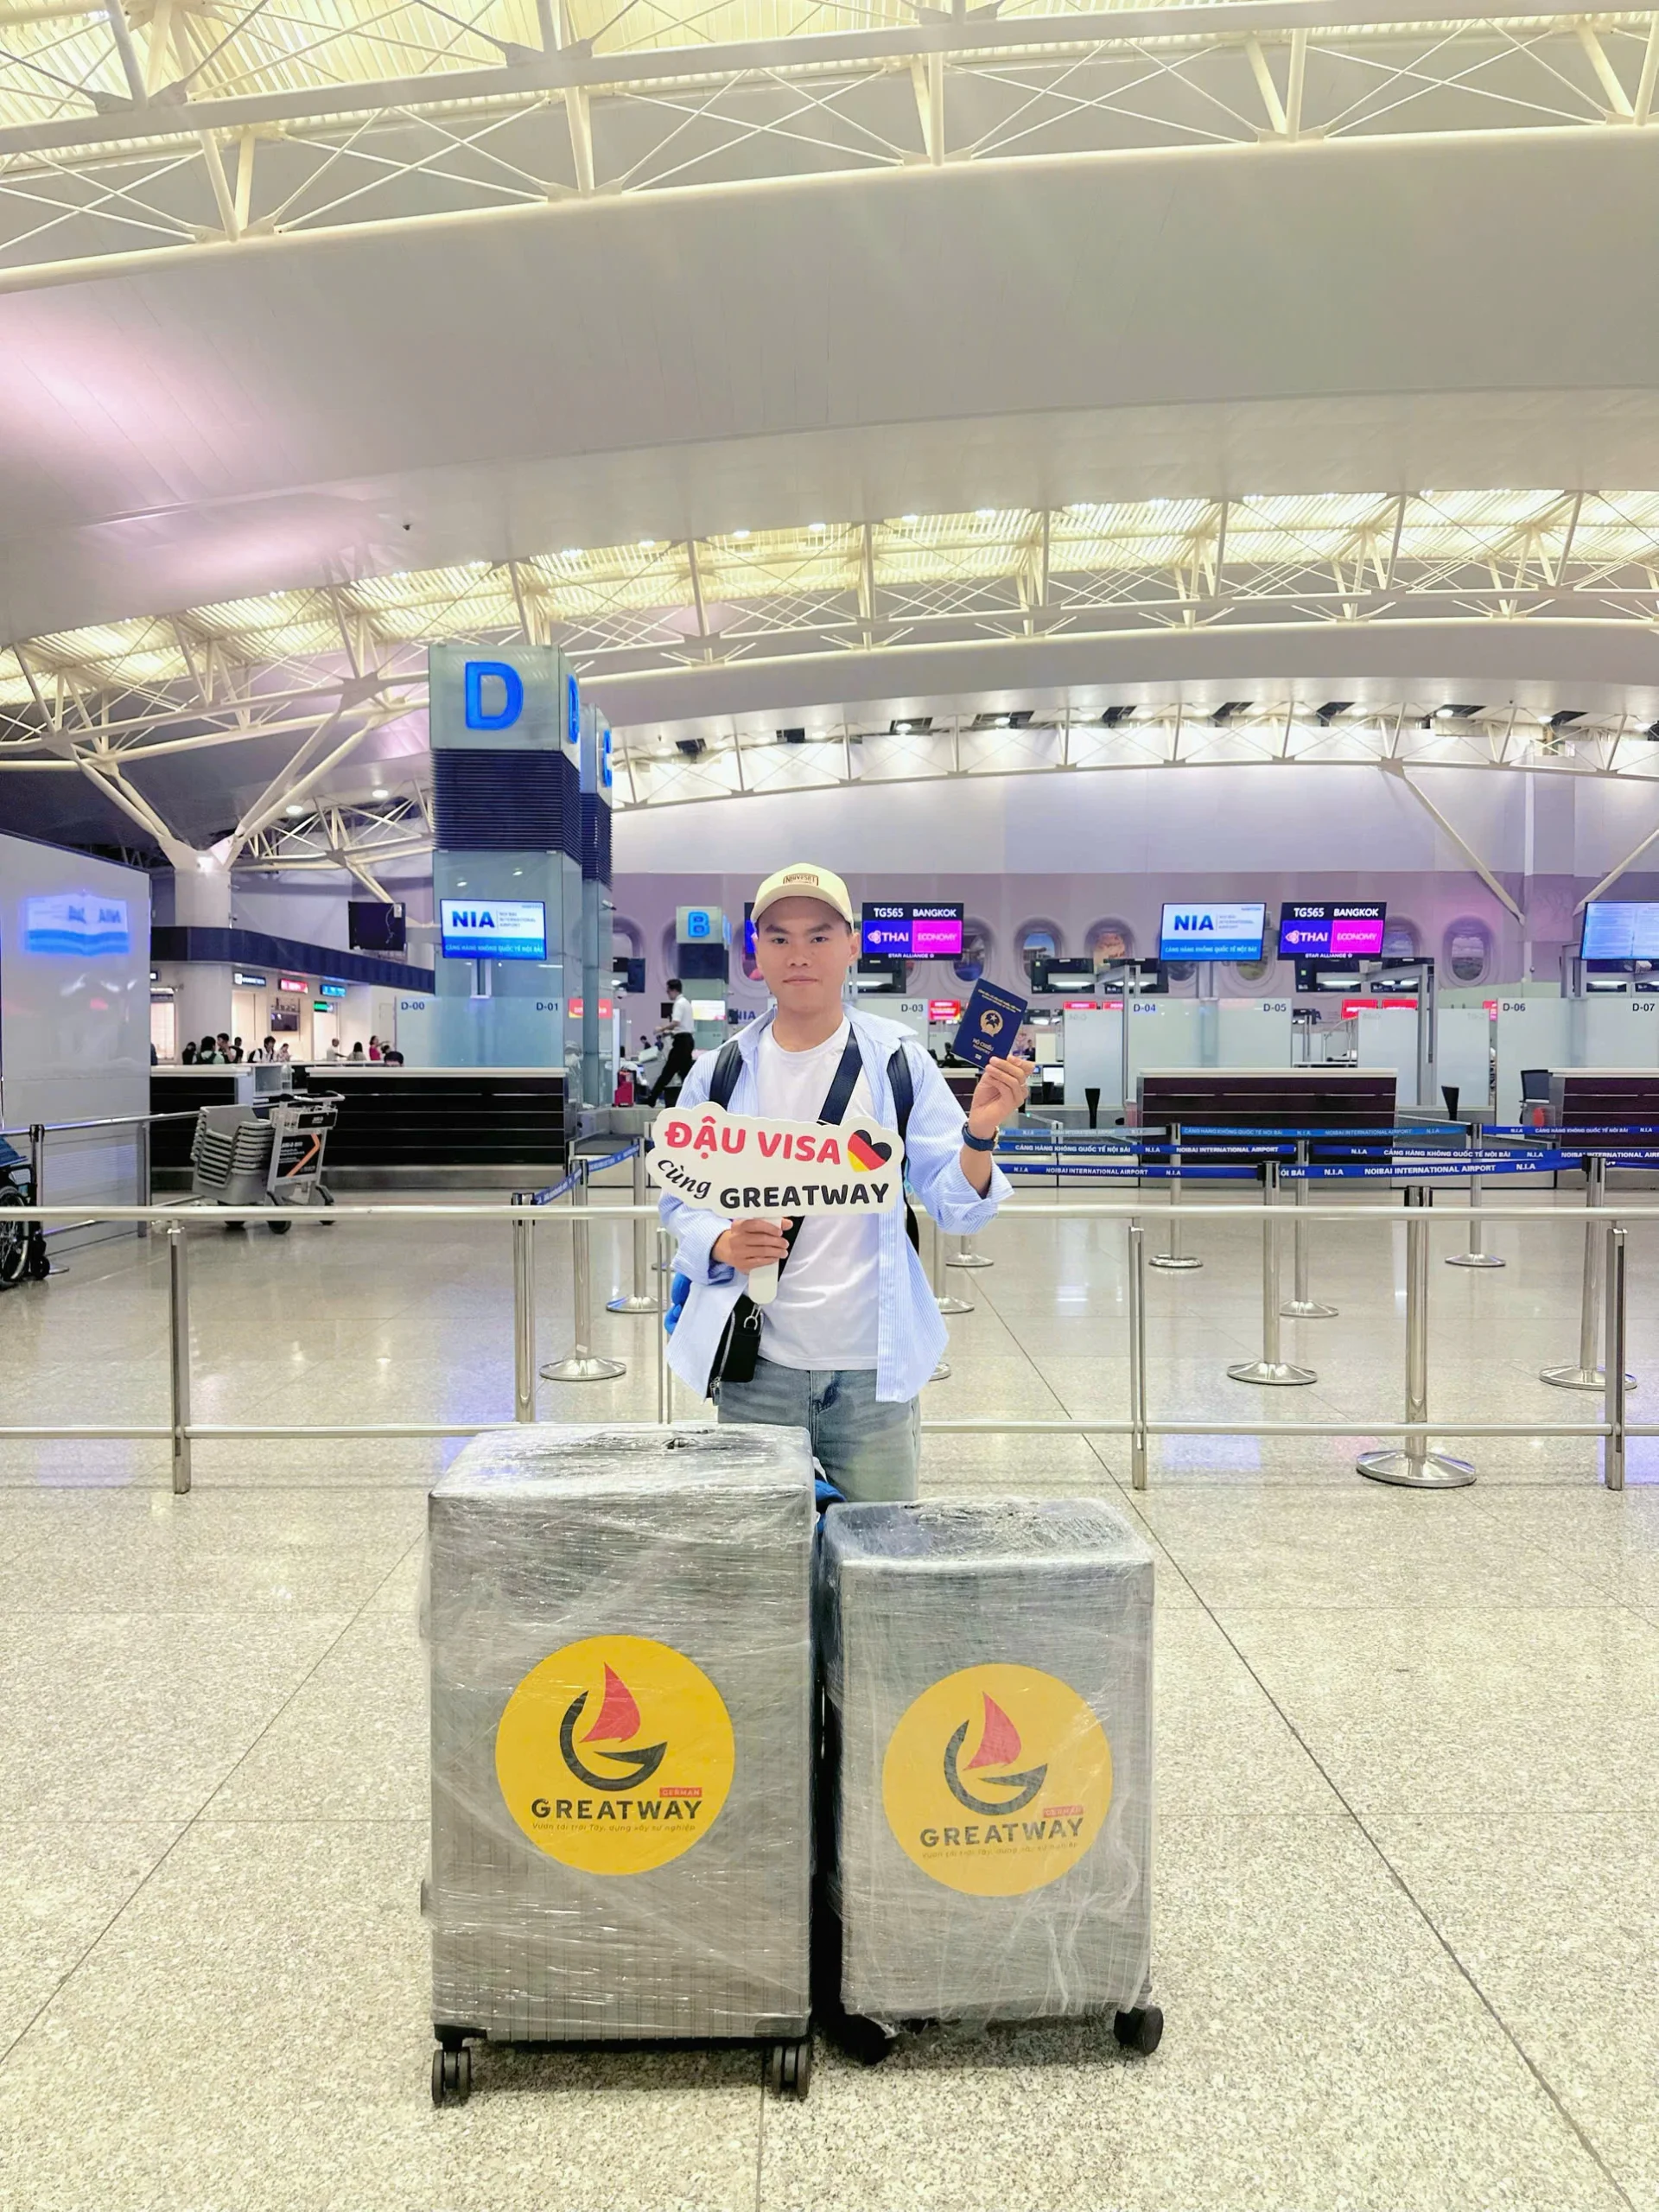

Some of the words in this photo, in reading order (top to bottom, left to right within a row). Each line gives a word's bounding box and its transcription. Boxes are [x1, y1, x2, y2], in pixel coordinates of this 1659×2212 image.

[465, 662, 524, 730] D
[874, 907, 904, 918] TG565
[912, 908, 957, 918] BANGKOK
[1294, 907, 1325, 918] TG565
[1333, 908, 1379, 917] BANGKOK
[452, 911, 495, 928] NIA
[688, 911, 710, 938] B
[1173, 914, 1214, 931] NIA
[881, 931, 909, 942] THAI
[1300, 931, 1329, 942] THAI
[401, 1001, 425, 1011] D-00
[536, 1001, 559, 1011] D-01
[901, 1003, 924, 1012] D-03
[1133, 1003, 1156, 1012] D-04
[1263, 1003, 1287, 1012] D-05
[1503, 1002, 1526, 1012] D-06
[1632, 1002, 1655, 1012] D-07
[664, 1116, 746, 1159] ĐẬU
[758, 1131, 841, 1165] VISA
[658, 1160, 711, 1199] cùng
[720, 1183, 889, 1209] GREATWAY
[531, 1798, 702, 1820] GREATWAY
[919, 1817, 1084, 1847] GREATWAY
